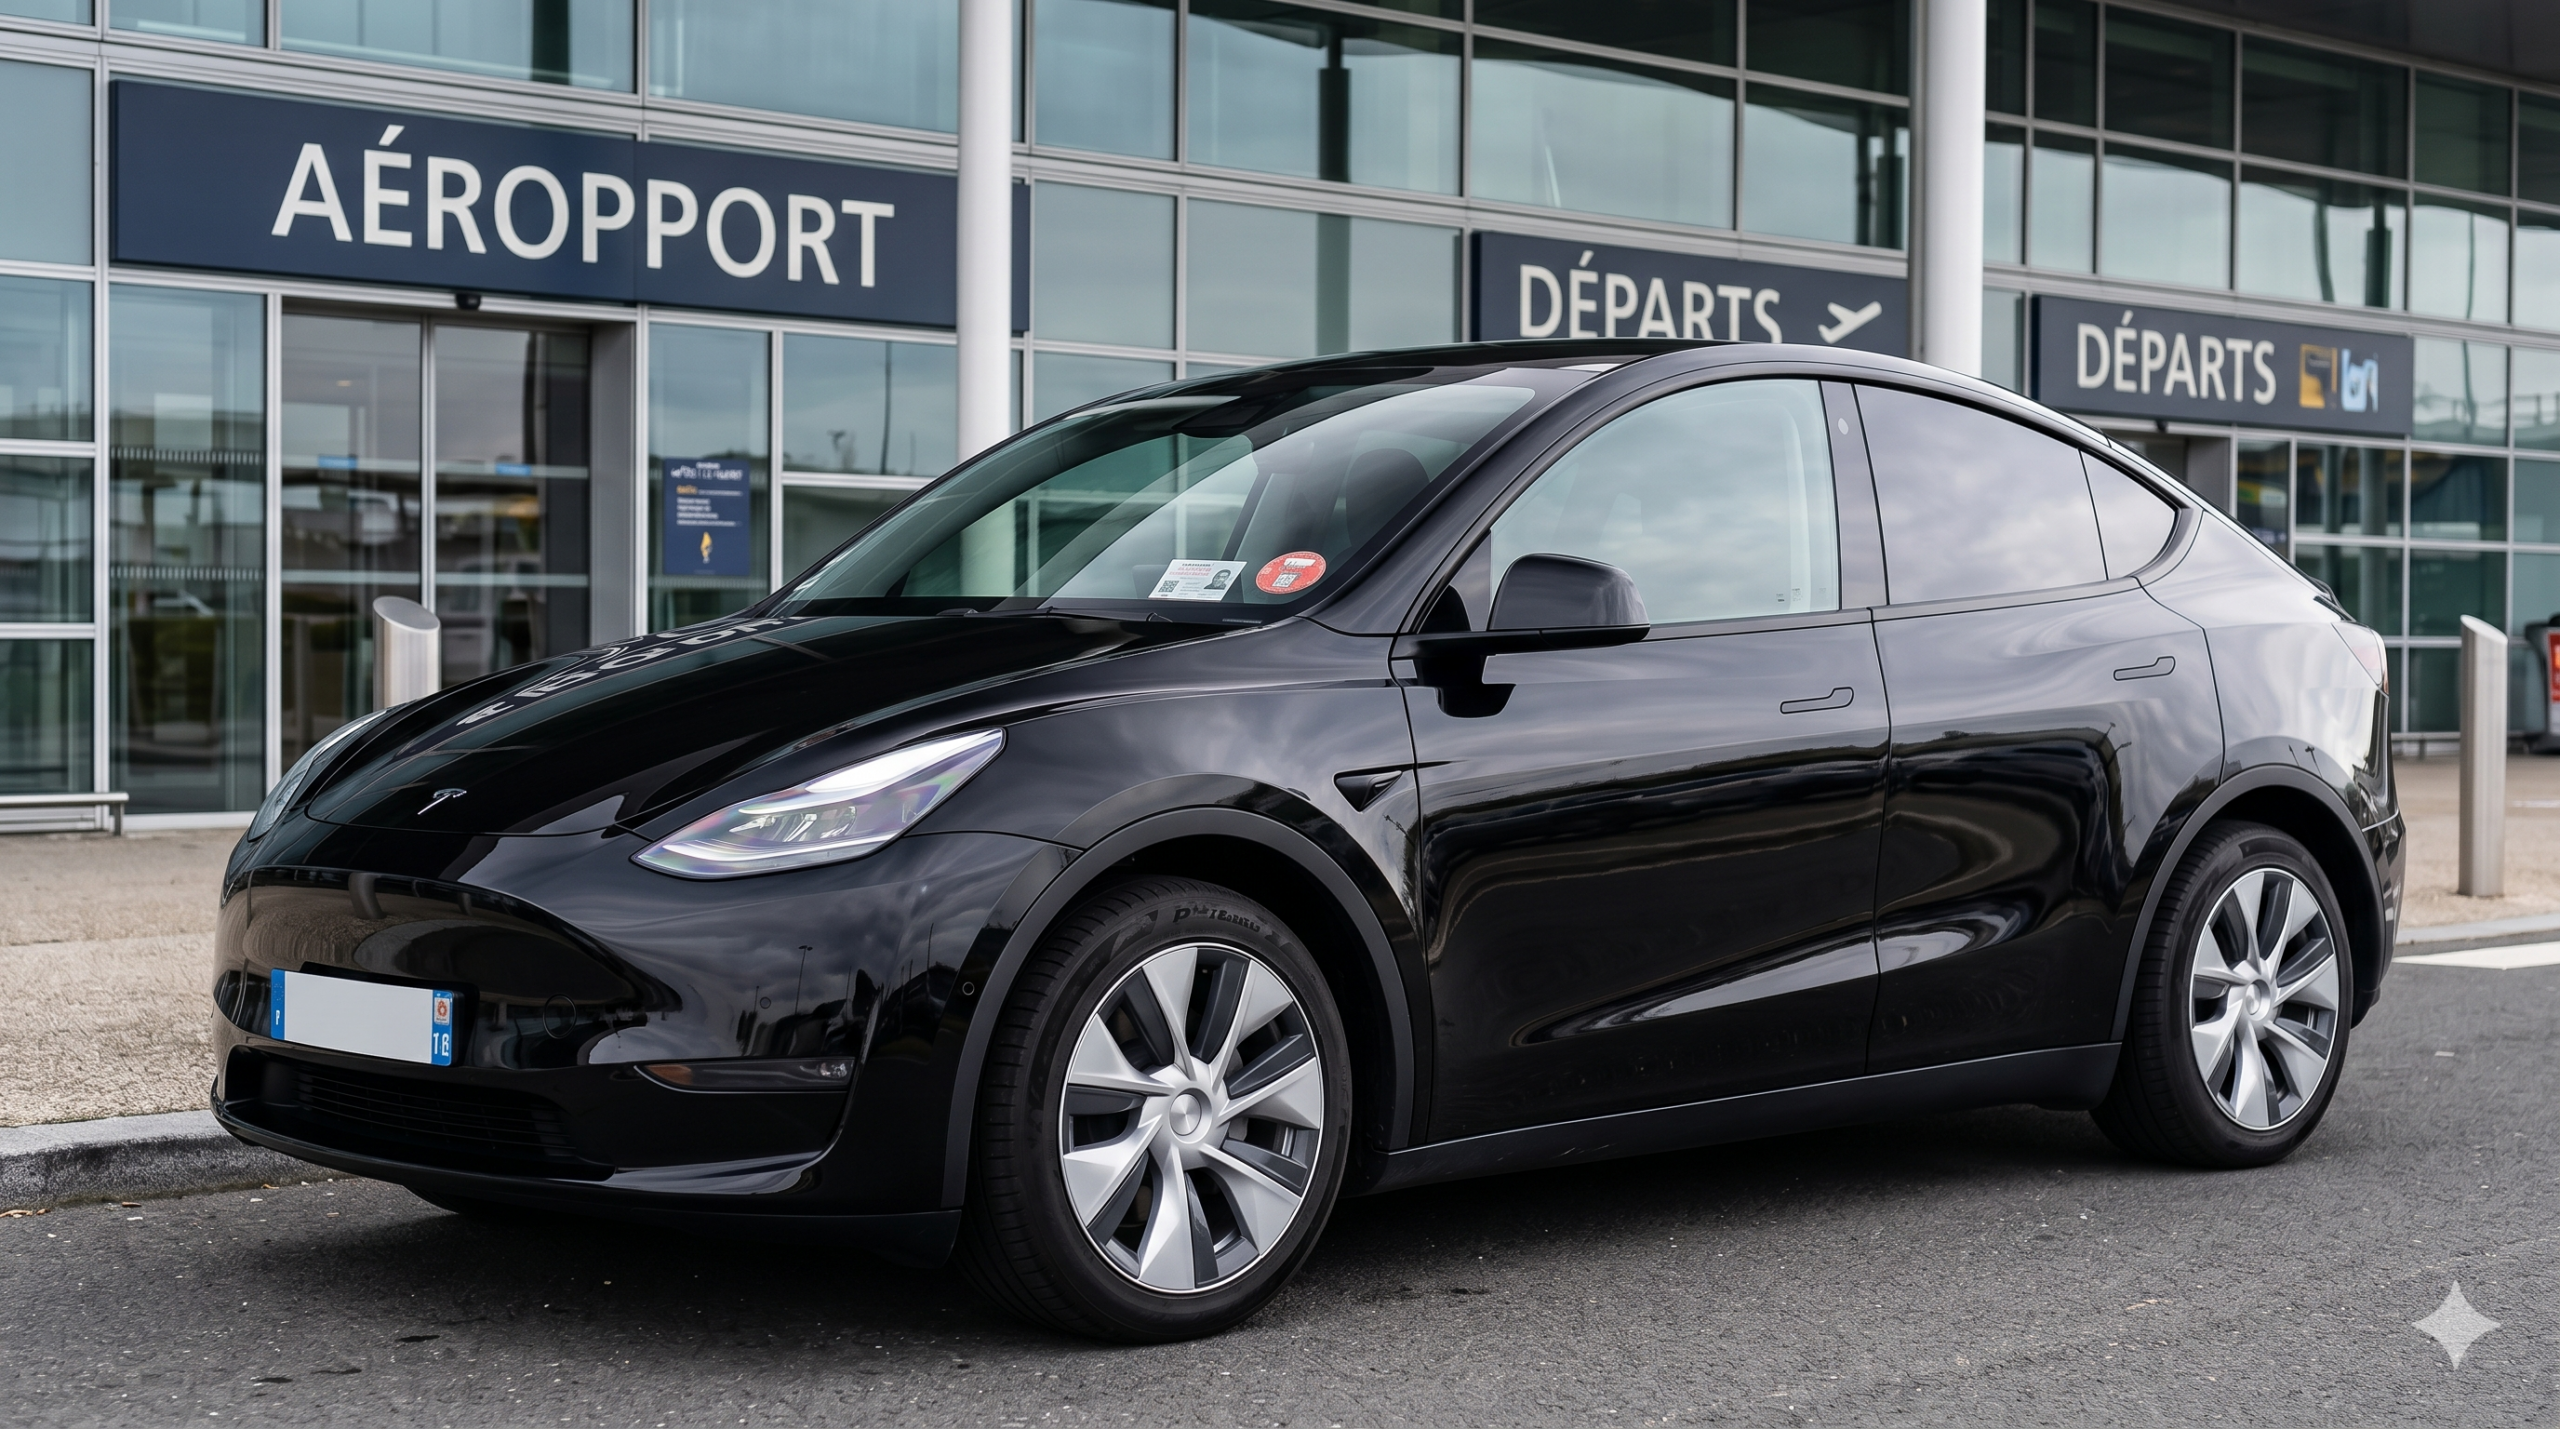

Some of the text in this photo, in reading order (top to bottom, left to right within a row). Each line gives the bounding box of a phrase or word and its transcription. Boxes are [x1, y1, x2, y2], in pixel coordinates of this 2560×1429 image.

[271, 124, 895, 288] AÉROPPORT
[1519, 250, 1783, 344] DÉPARTS
[2077, 310, 2277, 405] DÉPARTS
